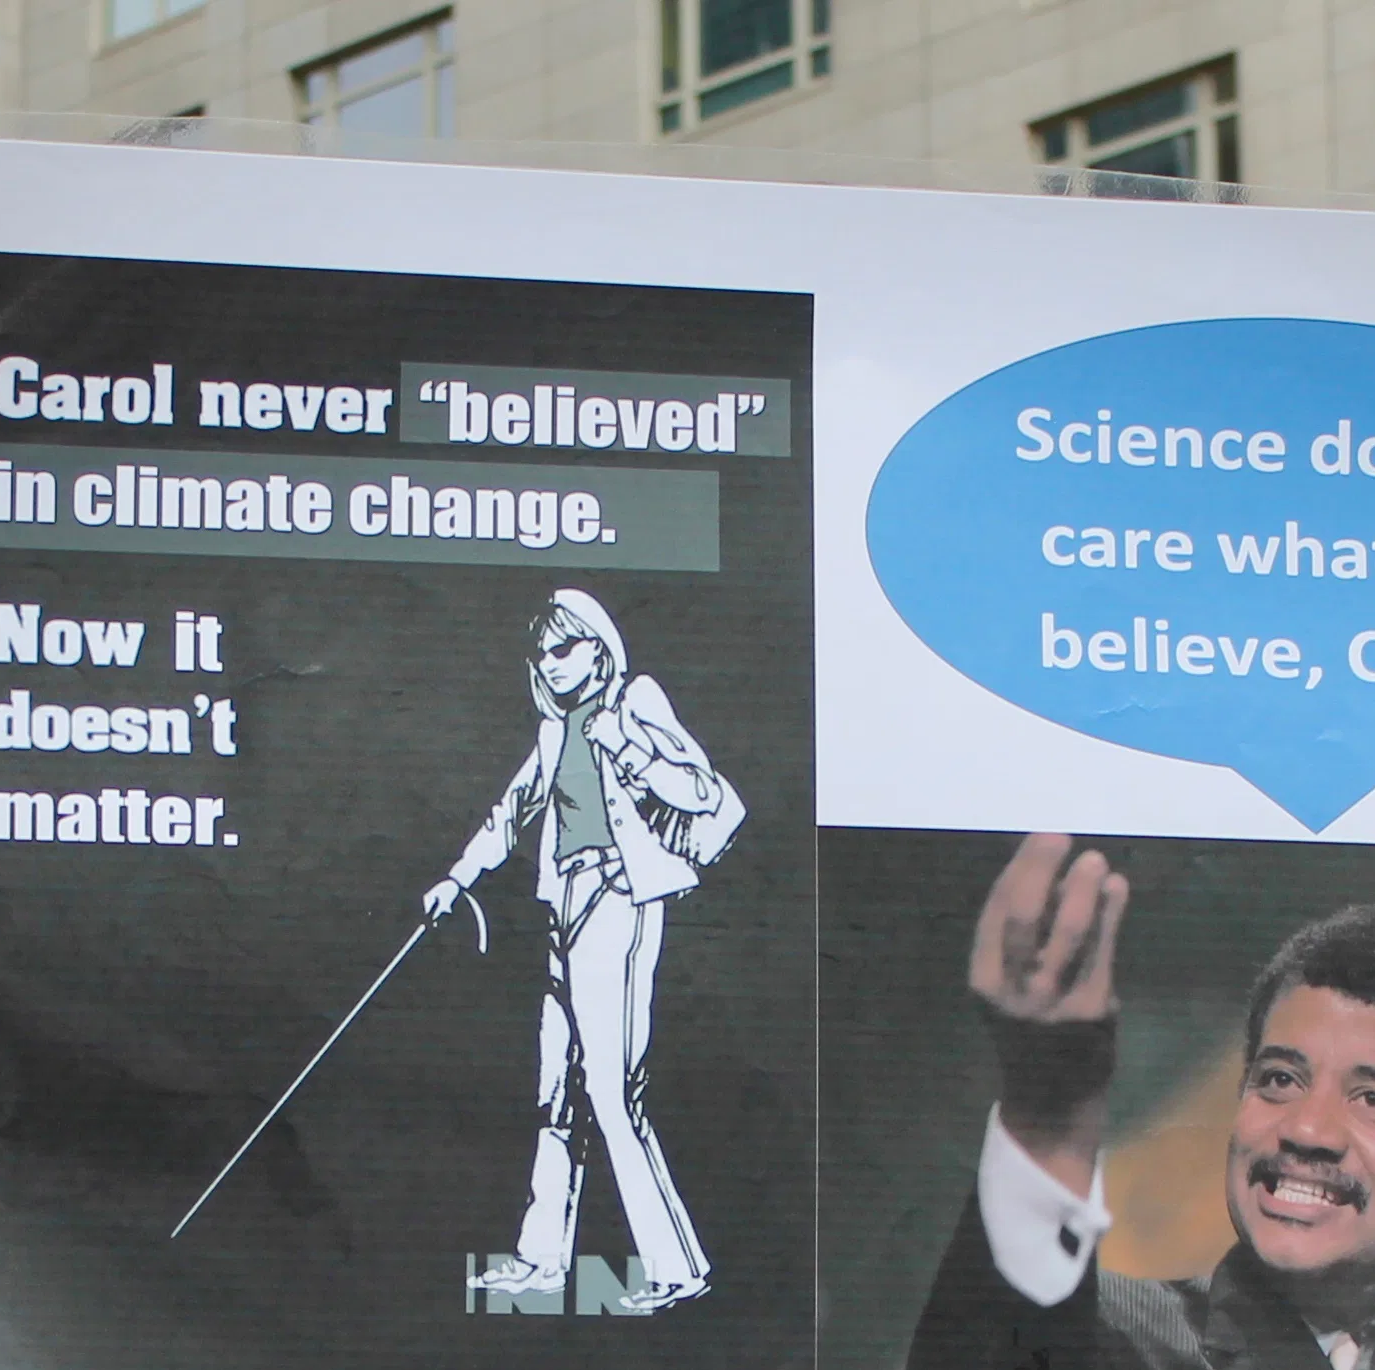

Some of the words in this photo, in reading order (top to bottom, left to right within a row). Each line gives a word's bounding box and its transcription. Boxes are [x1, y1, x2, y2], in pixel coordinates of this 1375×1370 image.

[198, 380, 393, 434] never
[1014, 406, 1287, 473] Science
[72, 464, 333, 534] climate
[348, 474, 617, 549] change.
[1040, 524, 1195, 572] care
[174, 610, 224, 673] it
[1040, 611, 1325, 691] believe,
